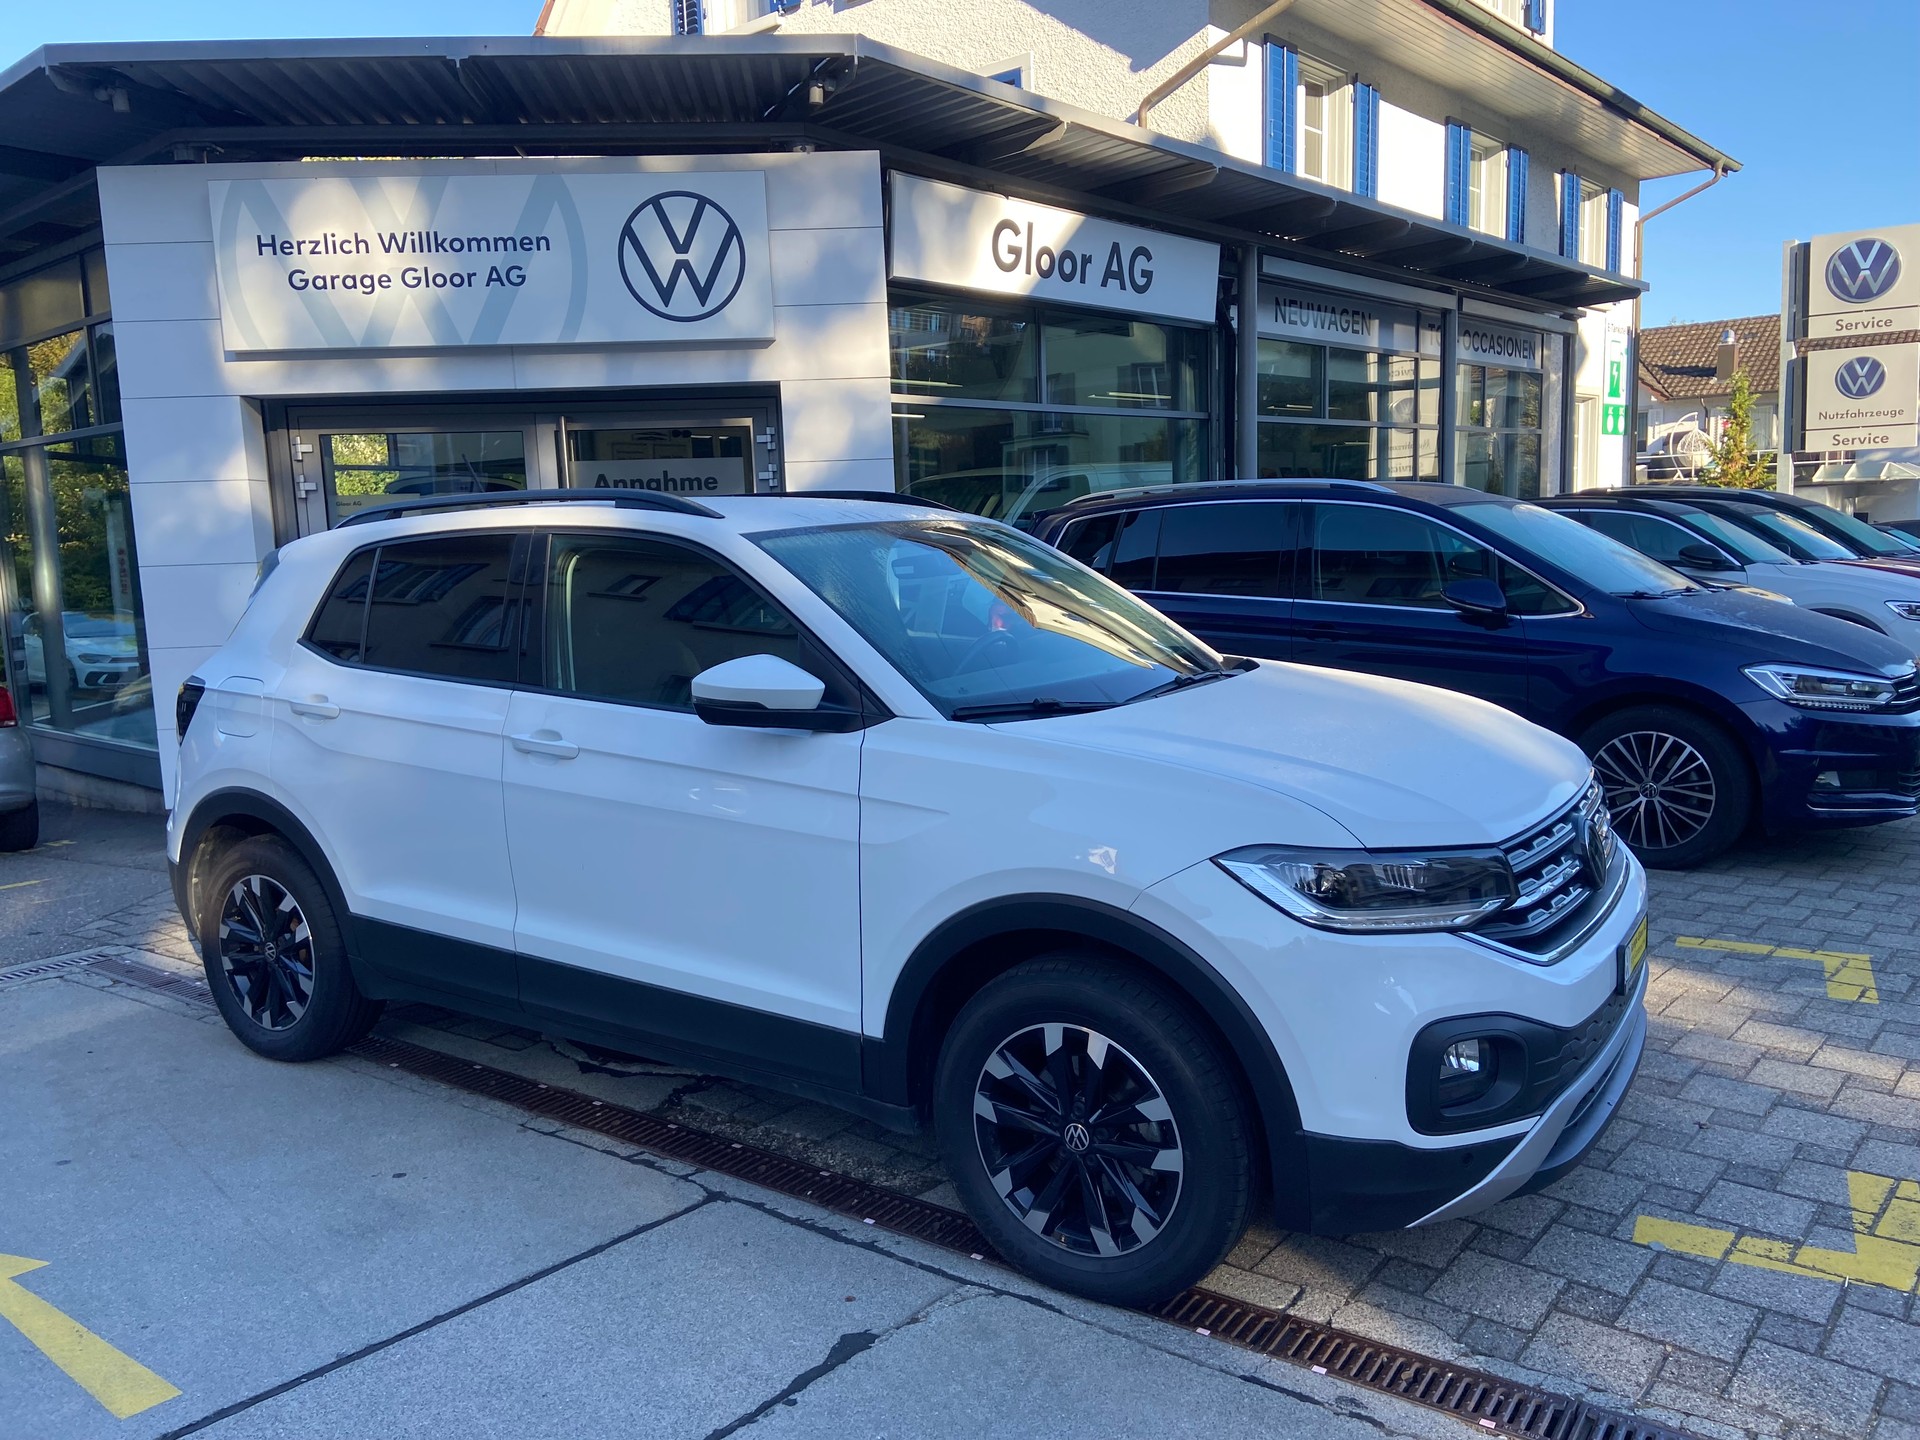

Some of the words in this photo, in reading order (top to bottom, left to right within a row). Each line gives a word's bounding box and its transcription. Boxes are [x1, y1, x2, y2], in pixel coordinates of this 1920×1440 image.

[256, 233, 370, 256] Herzlich
[377, 231, 551, 253] Willkommen
[992, 219, 1093, 285] Gloor
[1100, 241, 1154, 295] AG
[288, 269, 392, 295] Garage
[400, 266, 477, 289] Gloor
[485, 265, 527, 287] AG
[1274, 297, 1371, 337] NEUWAGEN
[1835, 316, 1893, 332] Service
[1462, 329, 1536, 361] OCCASIONEN
[1818, 408, 1905, 421] Nutzfahrzeuge
[1832, 433, 1889, 446] Service
[595, 470, 718, 492] Annahme
